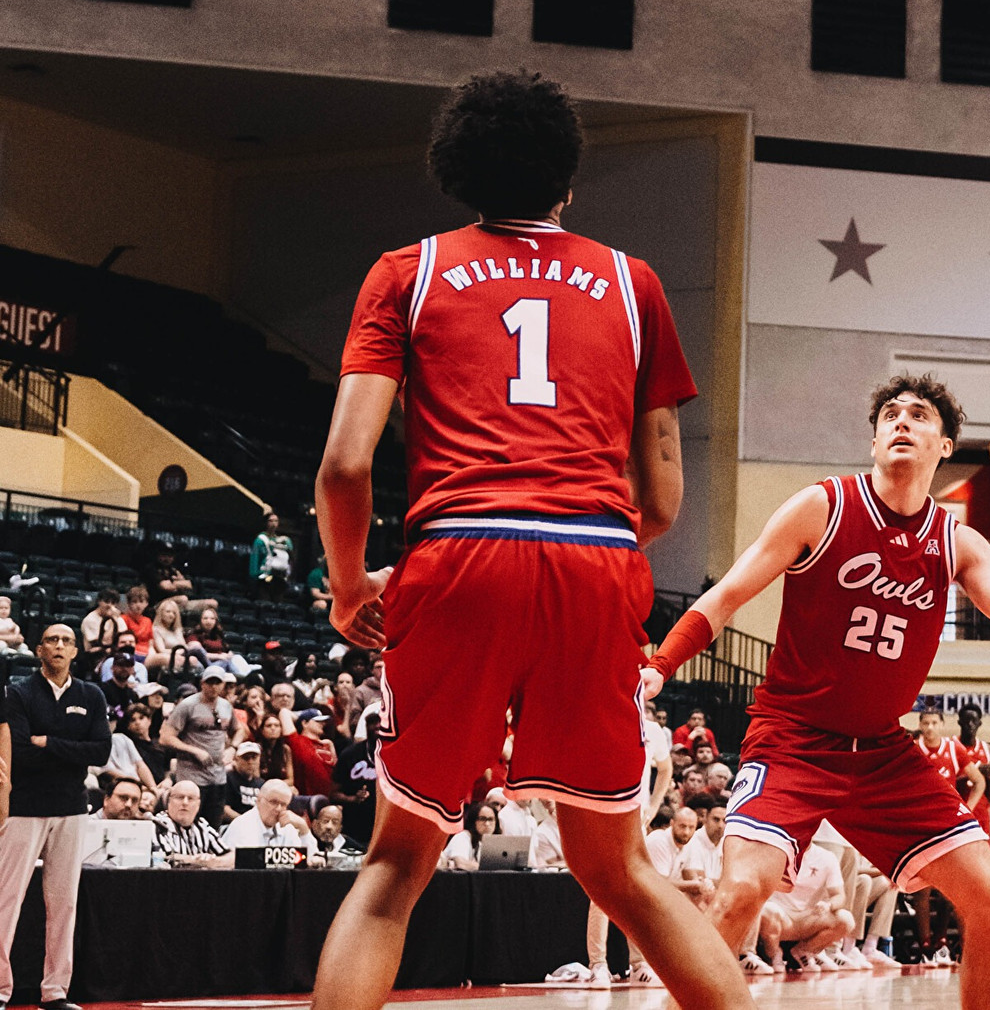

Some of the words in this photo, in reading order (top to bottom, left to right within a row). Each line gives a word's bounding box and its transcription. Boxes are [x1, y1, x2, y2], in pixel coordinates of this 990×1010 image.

[440, 257, 610, 301] WILLIAMS
[501, 297, 557, 408] 1
[838, 552, 935, 610] Owls
[844, 606, 908, 660] 25
[264, 847, 296, 864] POSS
